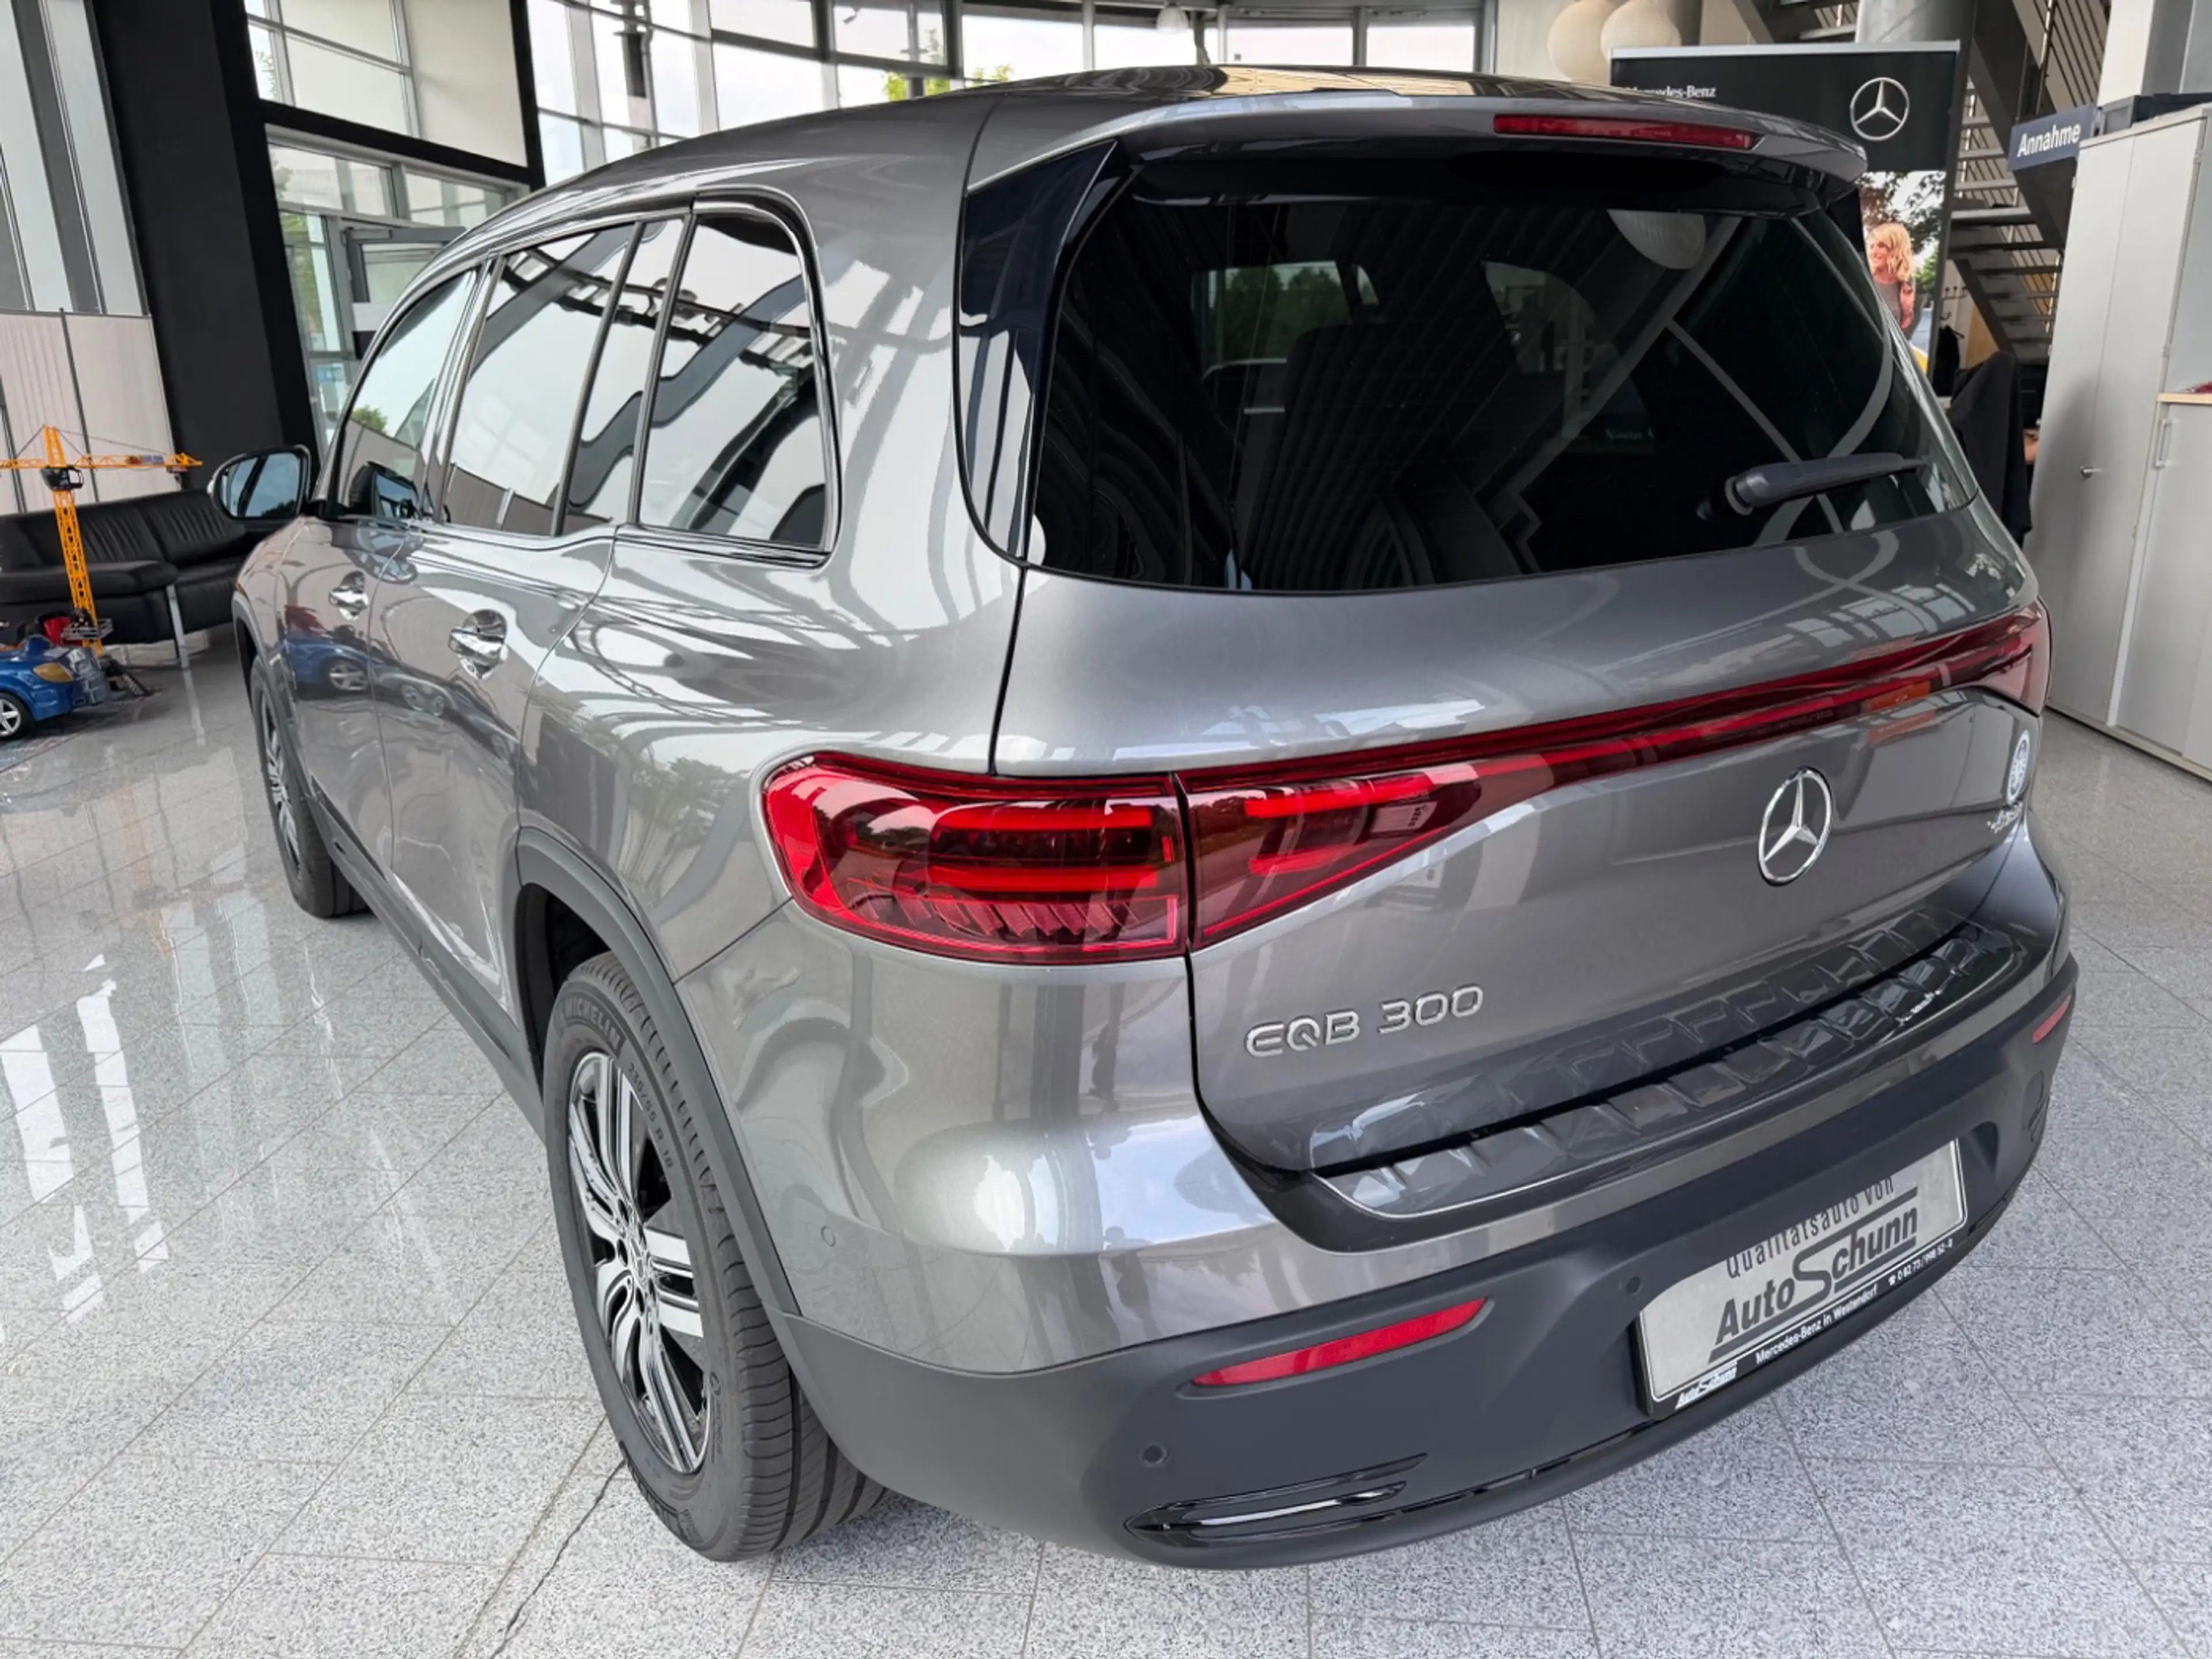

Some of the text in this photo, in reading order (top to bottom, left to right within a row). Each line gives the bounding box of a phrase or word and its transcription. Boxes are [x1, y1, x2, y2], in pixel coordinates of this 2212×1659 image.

[2017, 123, 2081, 158] Annahme
[565, 997, 622, 1051] MICHELIN
[1245, 984, 1484, 1058] EQB 300
[1864, 1176, 1894, 1206] von
[1756, 1319, 1821, 1365] Mercedes-Benz
[1823, 1313, 1833, 1327] in
